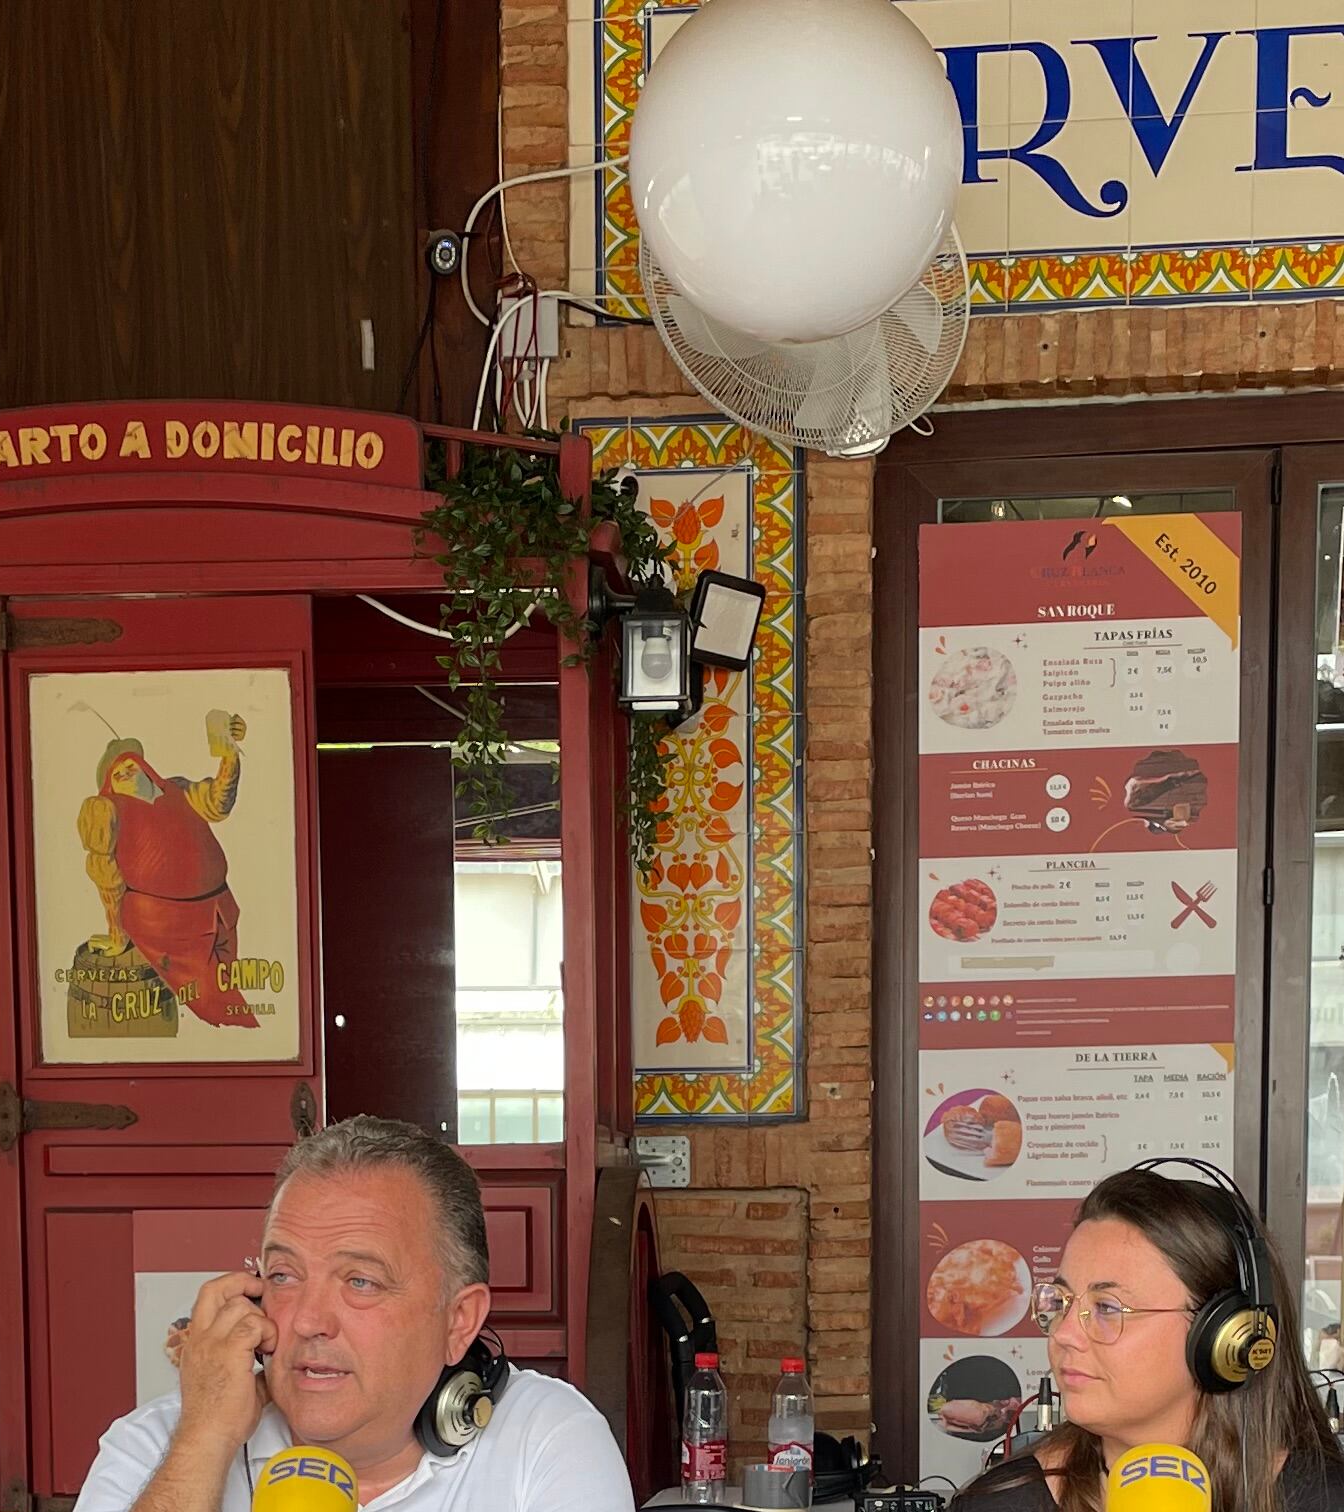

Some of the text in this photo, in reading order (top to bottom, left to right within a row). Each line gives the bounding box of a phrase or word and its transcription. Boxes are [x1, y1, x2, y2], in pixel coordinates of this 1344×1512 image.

[119, 420, 151, 458] A
[165, 420, 384, 470] DOMICILIO
[1155, 533, 1217, 594] Est. 2010
[1037, 603, 1115, 619] SAN ROQUE
[1094, 627, 1173, 641] TAPAS FRÍAS
[973, 759, 1036, 769] CHACINAS
[1046, 861, 1096, 869] PLANCHA
[55, 968, 139, 983] CERVEZAS
[81, 958, 284, 1023] LA CRUZ DEL CAMPO
[226, 1003, 276, 1016] SEVILLA
[1076, 1052, 1157, 1062] DE LA TIERRA
[268, 1458, 353, 1500] SER
[1120, 1456, 1206, 1494] SER
